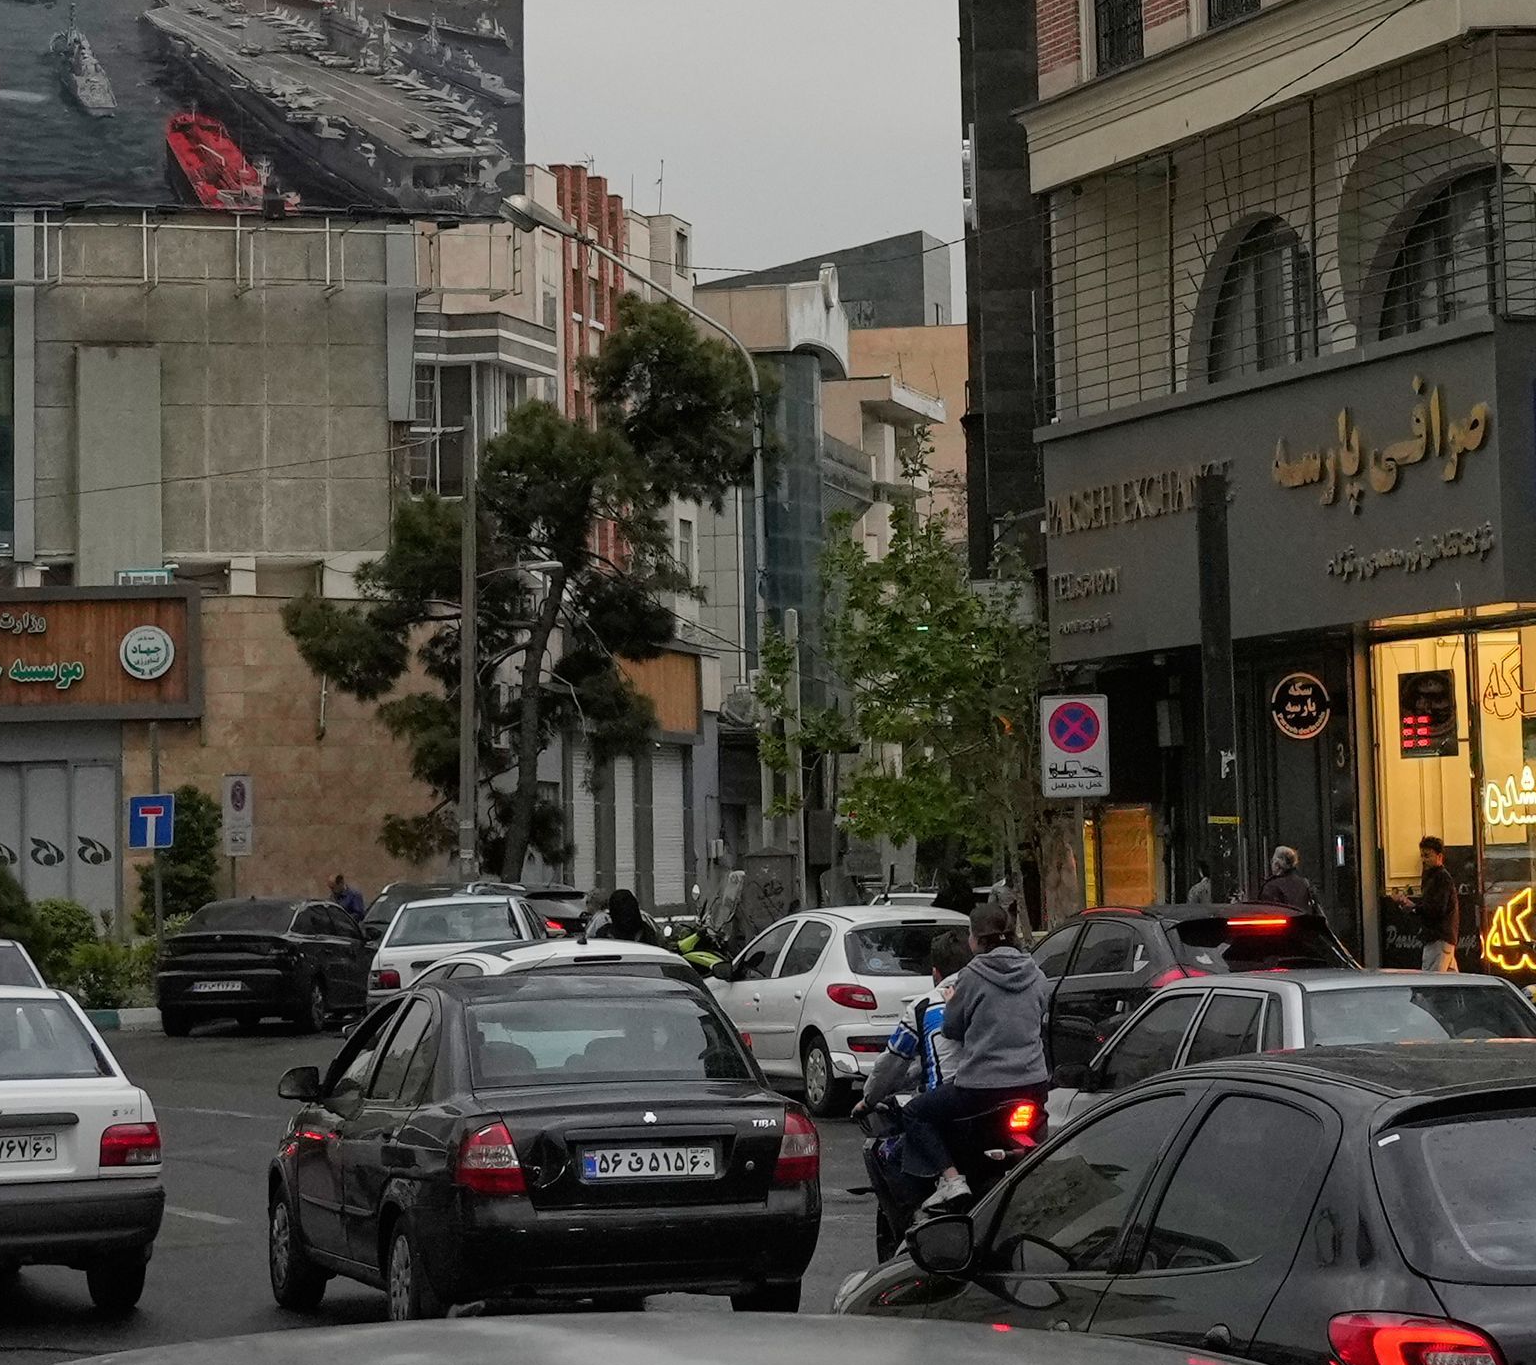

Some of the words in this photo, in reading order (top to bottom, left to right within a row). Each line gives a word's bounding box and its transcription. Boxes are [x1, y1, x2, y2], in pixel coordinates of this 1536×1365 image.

[1369, 373, 1492, 495] صرافی
[1272, 406, 1362, 516] پارسه
[1121, 458, 1241, 524] EXCHA
[0, 612, 47, 634] وزارت
[9, 658, 84, 689] موسسه
[1288, 682, 1313, 696] سکه
[751, 1119, 777, 1128] TIBA
